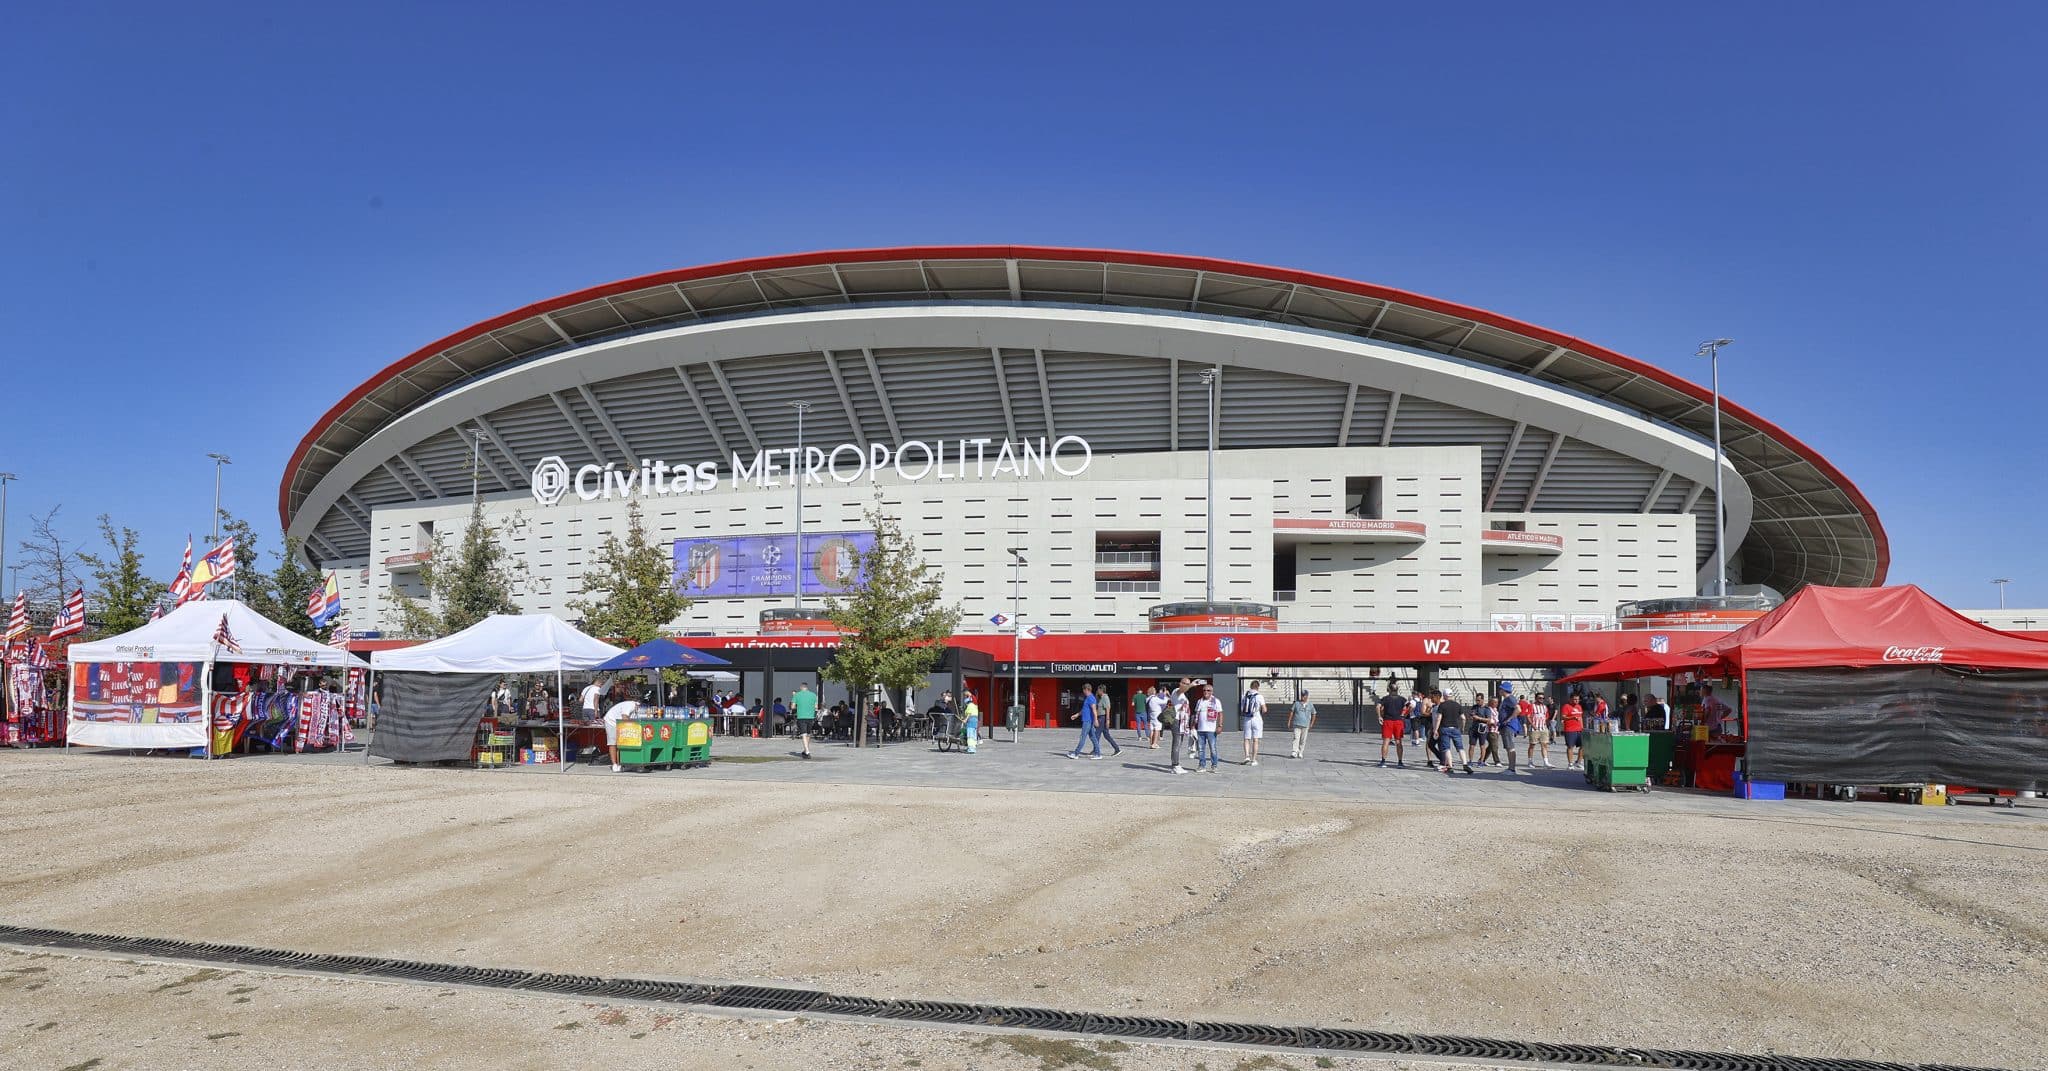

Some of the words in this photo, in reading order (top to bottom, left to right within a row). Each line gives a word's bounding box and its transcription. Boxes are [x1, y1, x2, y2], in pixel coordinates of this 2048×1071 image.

[575, 460, 717, 500] Cívitas
[732, 436, 1092, 488] METROPOLITANO
[1507, 533, 1534, 541] ATLÉTICO
[266, 647, 291, 655] Official
[1423, 639, 1450, 654] W2
[1883, 646, 1945, 662] Coca-Cola
